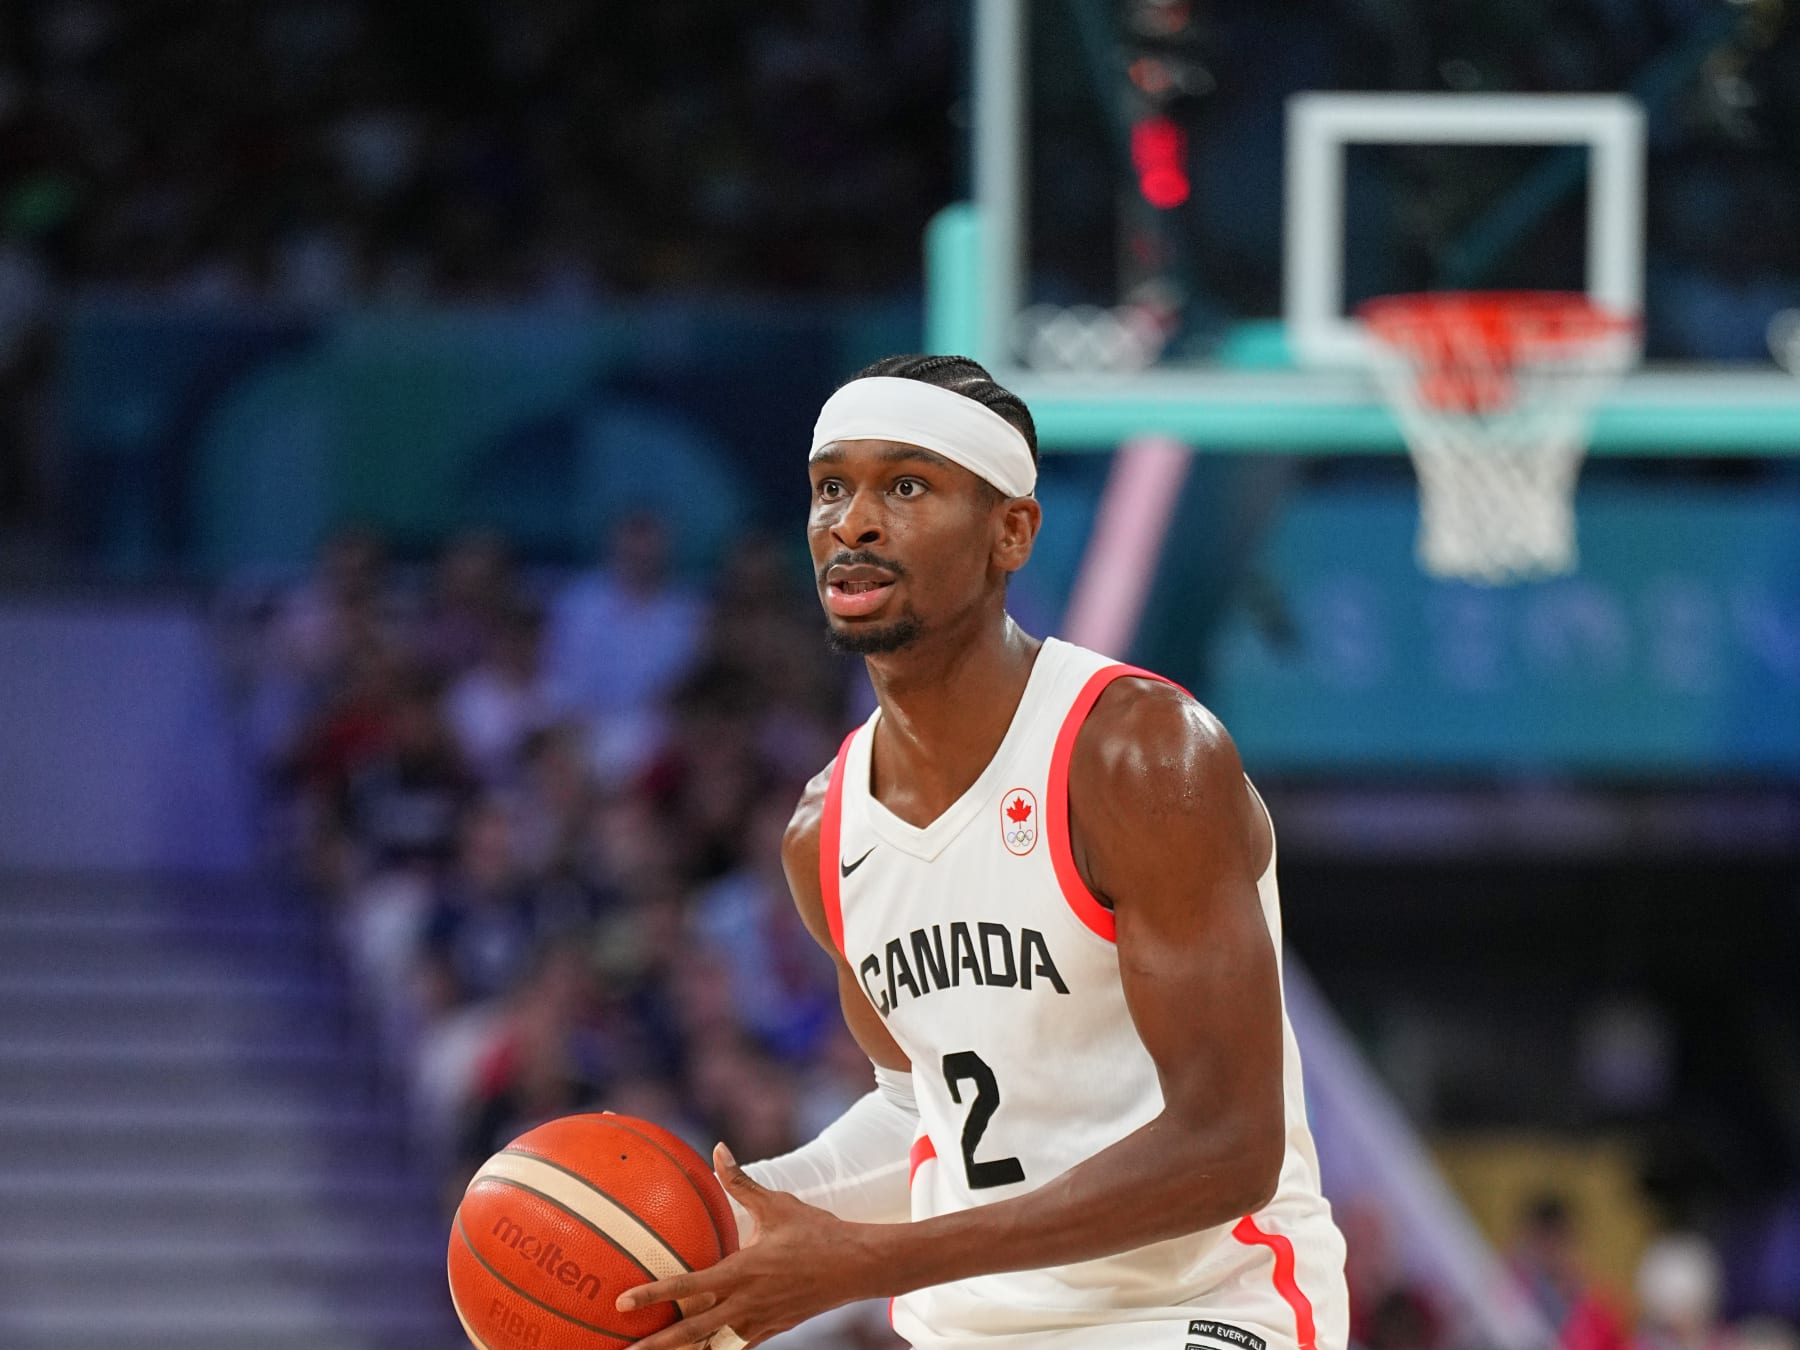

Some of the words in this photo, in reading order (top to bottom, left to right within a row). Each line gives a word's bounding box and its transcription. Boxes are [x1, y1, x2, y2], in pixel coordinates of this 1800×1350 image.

[860, 922, 1070, 1018] CANADA
[943, 1051, 1025, 1189] 2
[492, 1216, 602, 1300] molten
[489, 1298, 542, 1347] FIBA
[1192, 1323, 1215, 1333] ANY
[1217, 1326, 1248, 1343] EVERY
